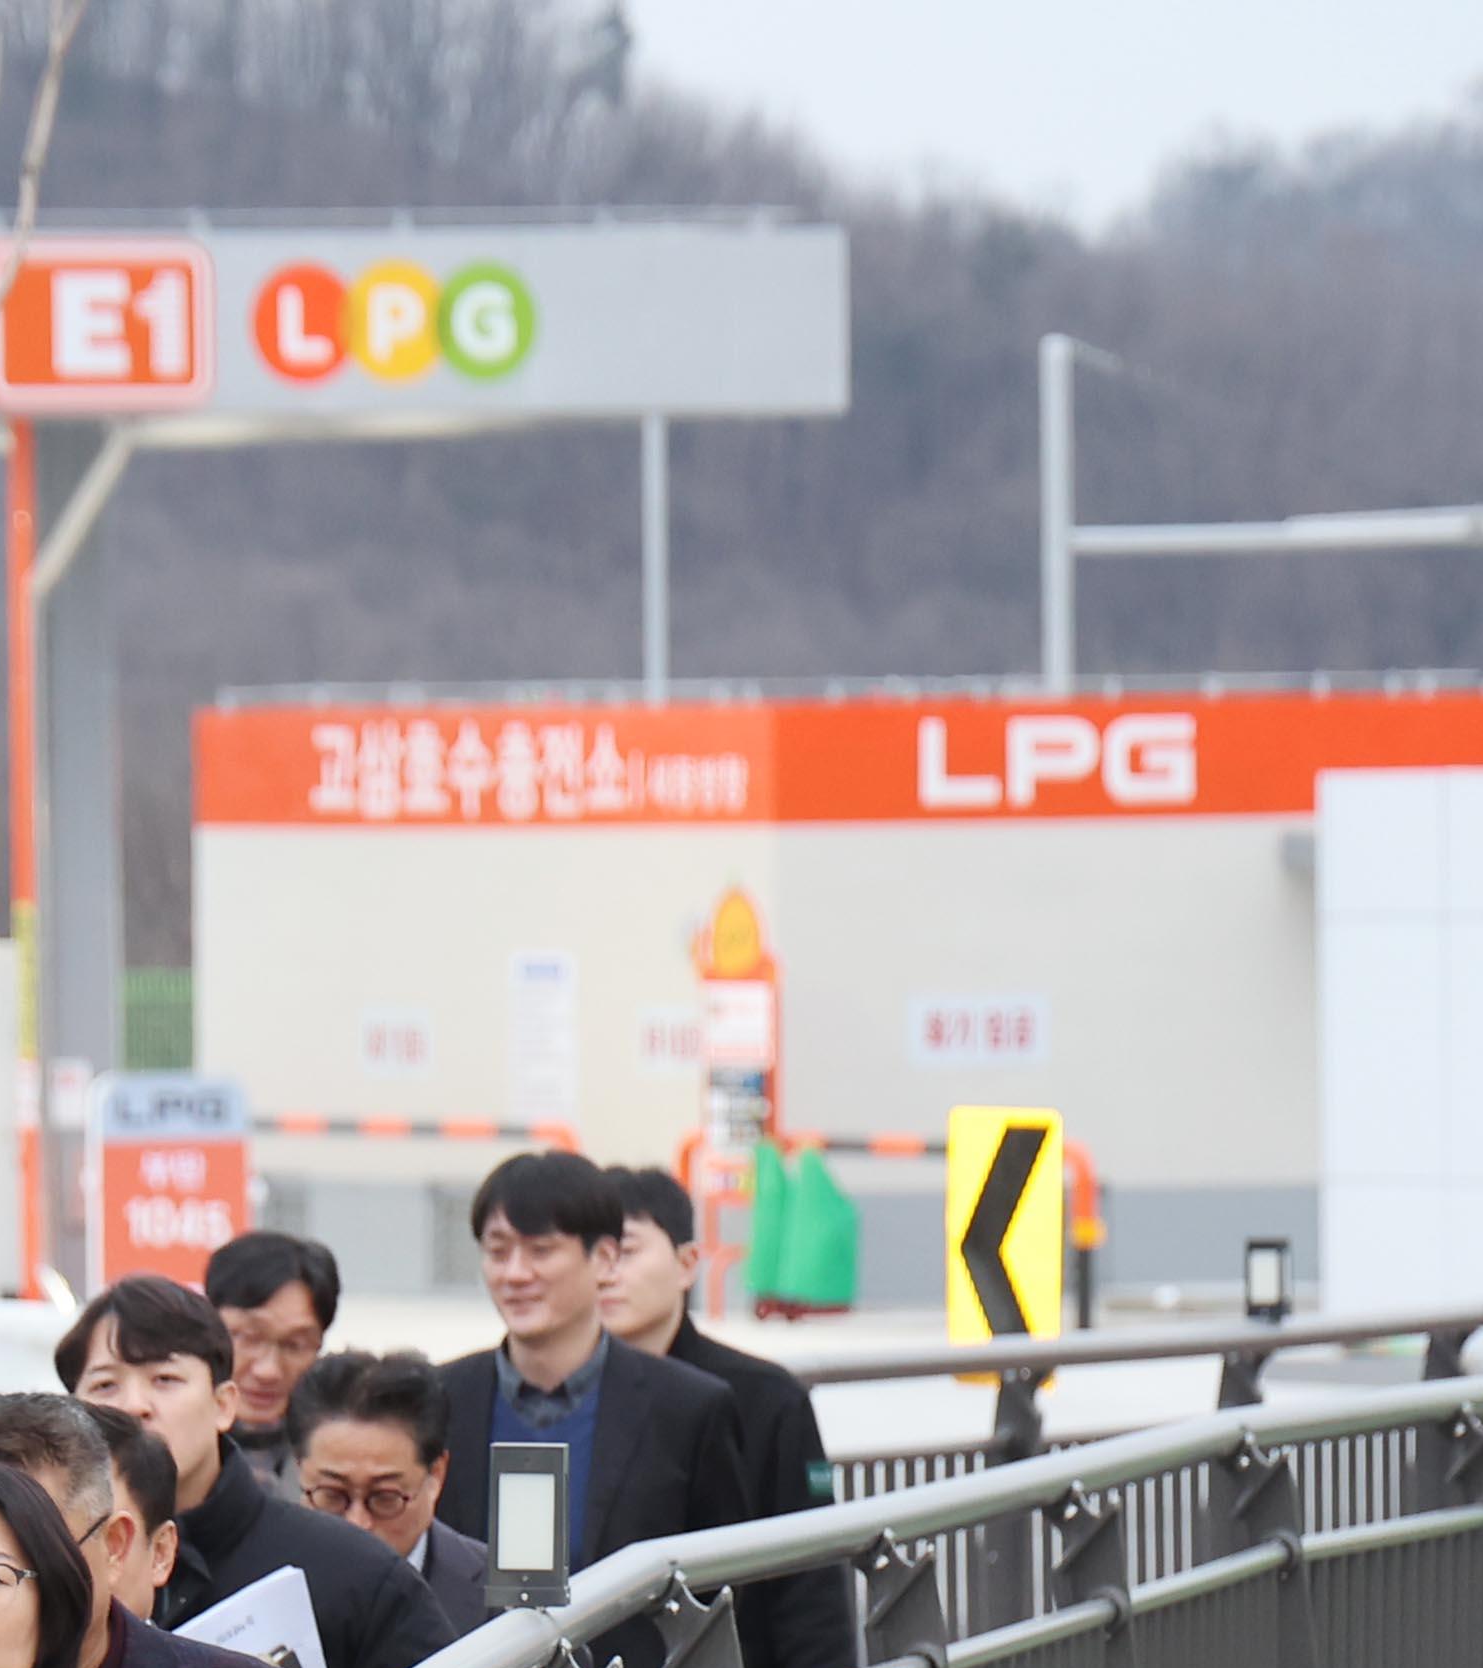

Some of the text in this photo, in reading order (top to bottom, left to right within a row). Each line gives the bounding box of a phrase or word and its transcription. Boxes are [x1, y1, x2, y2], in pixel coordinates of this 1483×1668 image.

[50, 267, 188, 378] E1
[275, 280, 519, 364] LPG
[918, 713, 1197, 810] LPG
[115, 1090, 225, 1126] LPG
